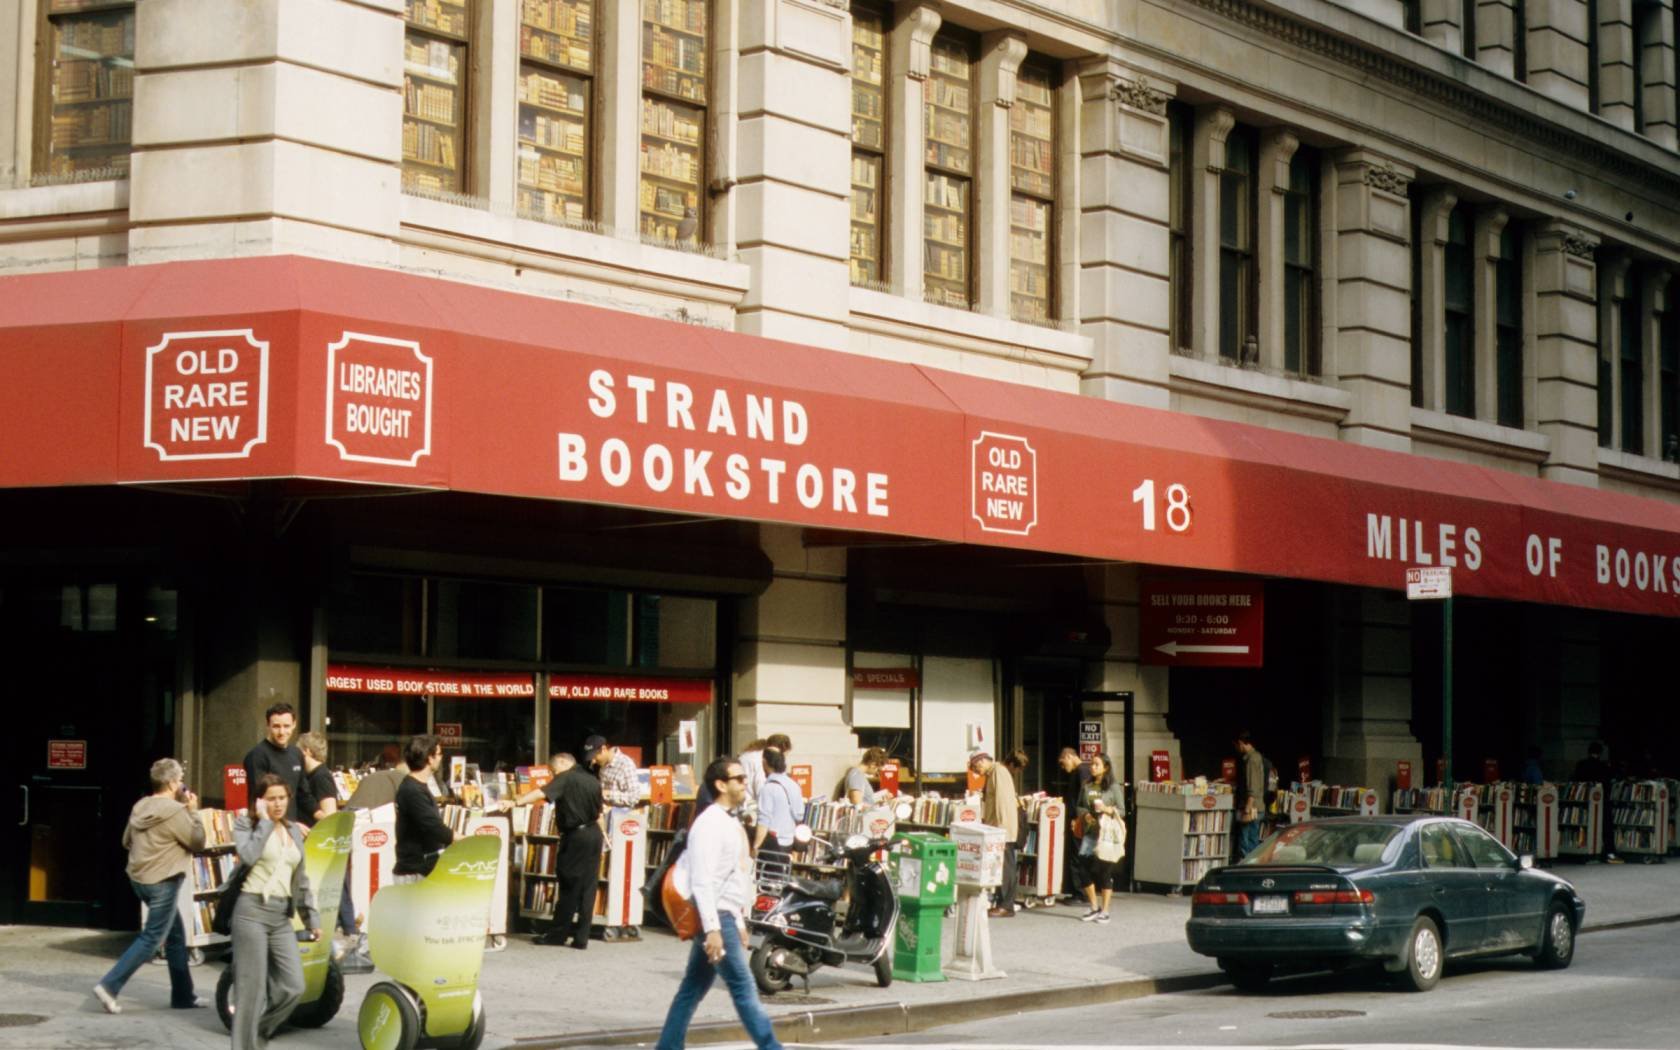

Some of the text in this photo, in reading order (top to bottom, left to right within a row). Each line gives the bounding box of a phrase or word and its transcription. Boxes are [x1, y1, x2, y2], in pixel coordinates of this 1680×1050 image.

[175, 348, 239, 376] OLD
[340, 361, 421, 401] LIBRARIES
[164, 381, 249, 409] RARE
[587, 368, 809, 446] STRAND
[170, 415, 241, 443] NEW
[346, 402, 413, 440] BOUGHT
[988, 446, 1022, 470] OLD
[557, 431, 889, 518] BOOKSTORE
[981, 471, 1028, 497] RARE
[986, 498, 1024, 521] NEW
[1132, 478, 1192, 533] 18
[1366, 512, 1483, 571] MILES
[1525, 533, 1563, 578] OF
[1408, 570, 1421, 583] NO
[1151, 594, 1252, 607] SELL YOUR BOOKS HERE
[1201, 627, 1238, 635] SATURDAY
[1206, 614, 1229, 625] 6:00
[326, 676, 362, 690] ARGEST
[366, 678, 394, 691] USED
[427, 681, 460, 694] STORE
[461, 683, 472, 695] IN
[473, 683, 494, 695] THE
[495, 683, 534, 695] WORLD
[867, 673, 905, 683] SPECIALS
[571, 685, 590, 697] OLD
[593, 686, 612, 698] AND
[613, 687, 637, 699] RARE
[638, 688, 669, 700] BOOKS
[440, 727, 455, 736] NO
[1081, 732, 1100, 740] EXIT
[1085, 724, 1097, 732] NO
[1085, 744, 1097, 752] NO
